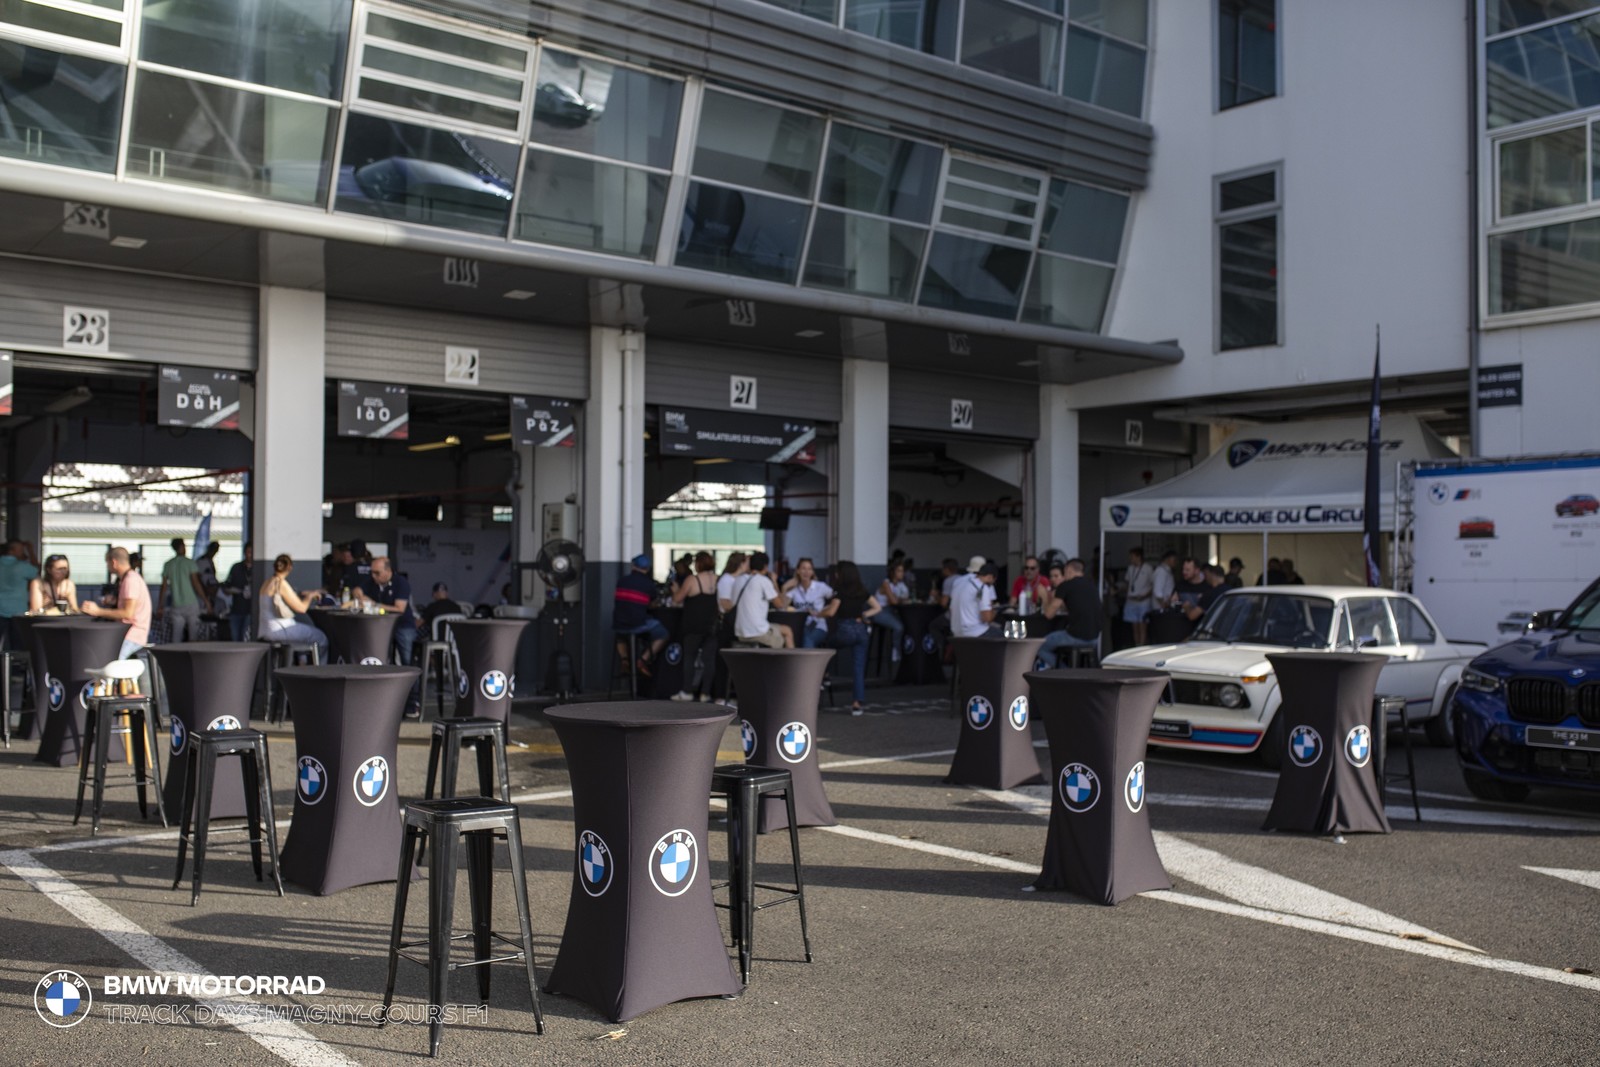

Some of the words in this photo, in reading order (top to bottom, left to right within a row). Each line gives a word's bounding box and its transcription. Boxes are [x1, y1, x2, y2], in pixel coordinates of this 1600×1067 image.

[66, 312, 107, 346] 23
[447, 353, 477, 381] 22
[176, 392, 190, 409] D
[209, 395, 222, 411] H
[733, 380, 754, 405] 21
[526, 417, 537, 431] P
[550, 419, 560, 432] Z
[952, 402, 972, 426] 20
[696, 430, 741, 443] SIMULATEURS
[752, 435, 783, 446] CONDUITE
[1127, 423, 1142, 443] 19
[908, 496, 1022, 526] Magny-Co
[1305, 505, 1364, 523] CIRCU
